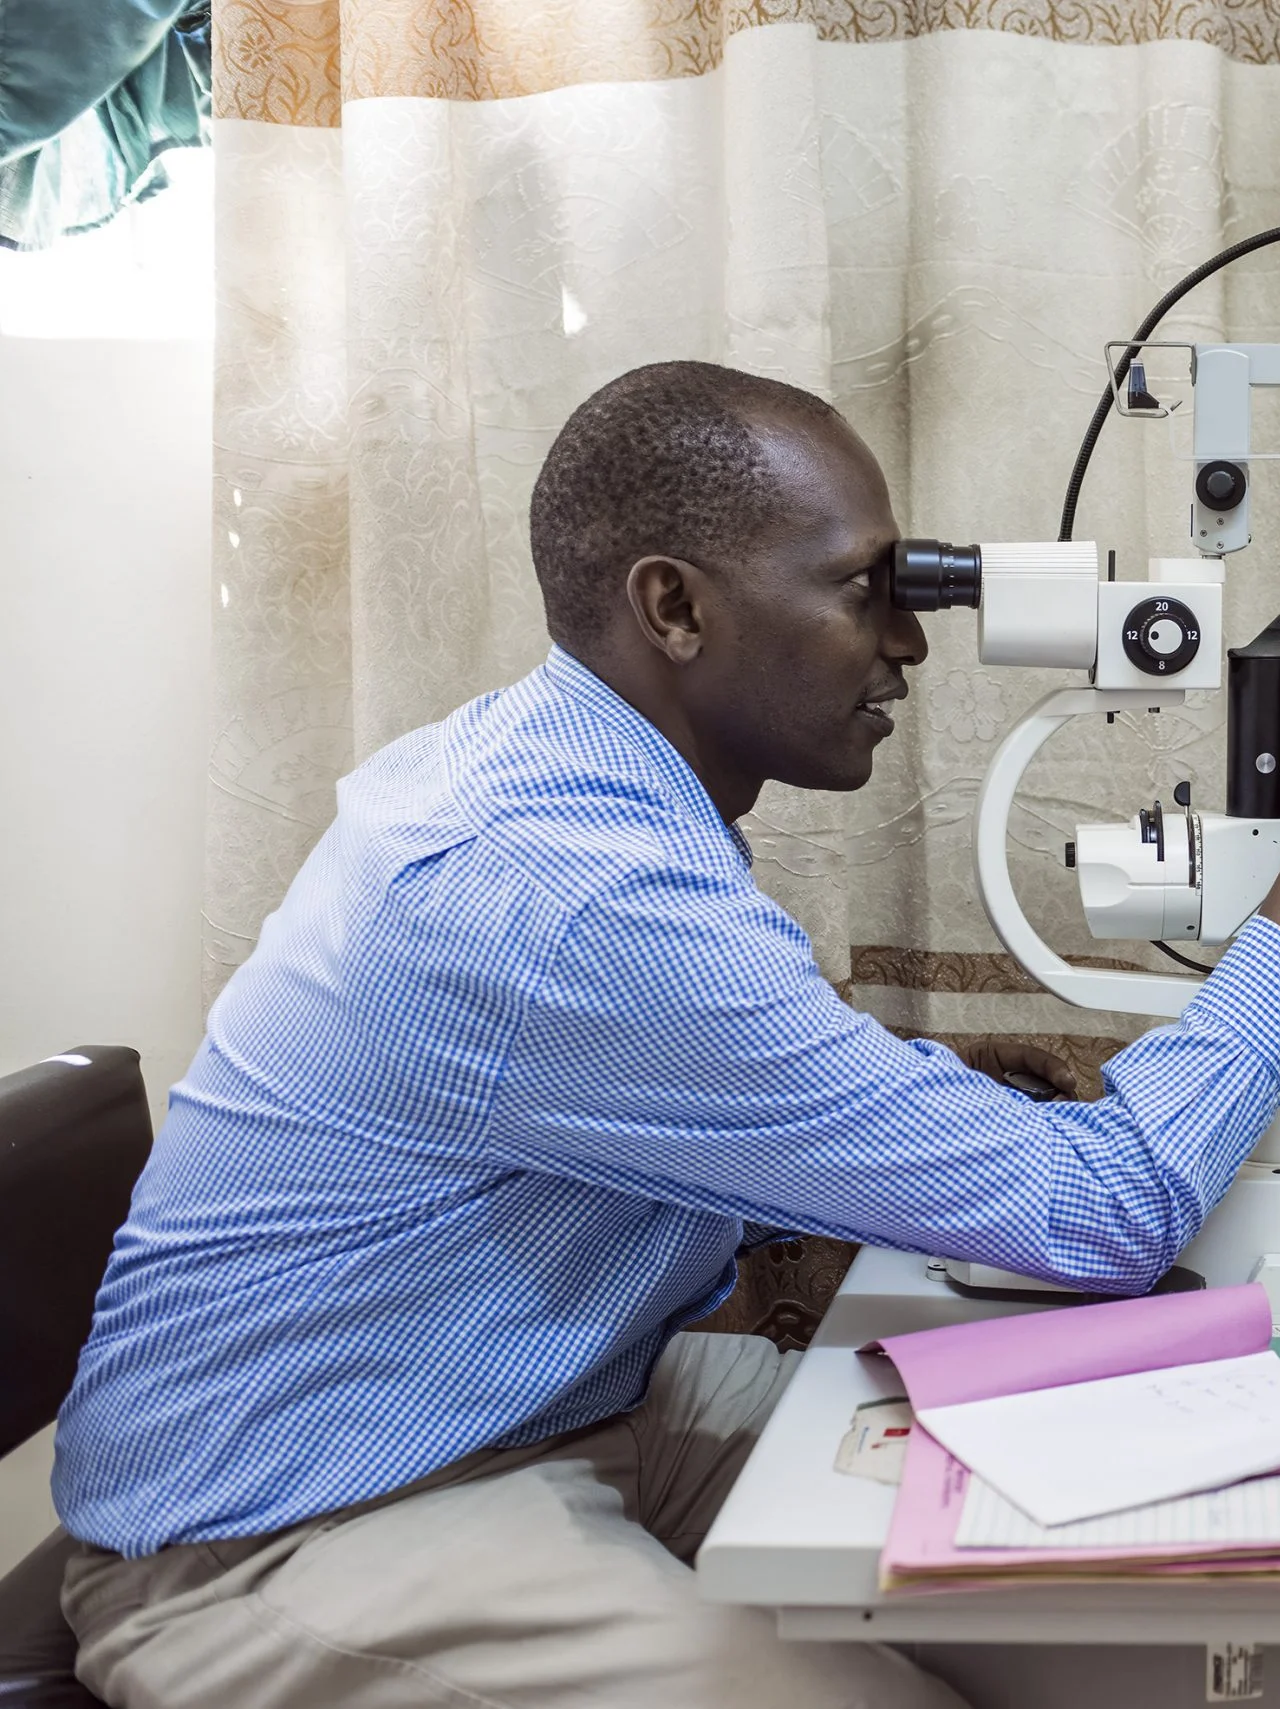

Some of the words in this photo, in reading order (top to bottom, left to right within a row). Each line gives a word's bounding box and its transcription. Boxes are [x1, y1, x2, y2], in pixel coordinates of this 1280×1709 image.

[1155, 601, 1169, 612] 20
[1126, 630, 1139, 640] 12
[1186, 630, 1198, 640] 12
[1158, 660, 1166, 670] 8
